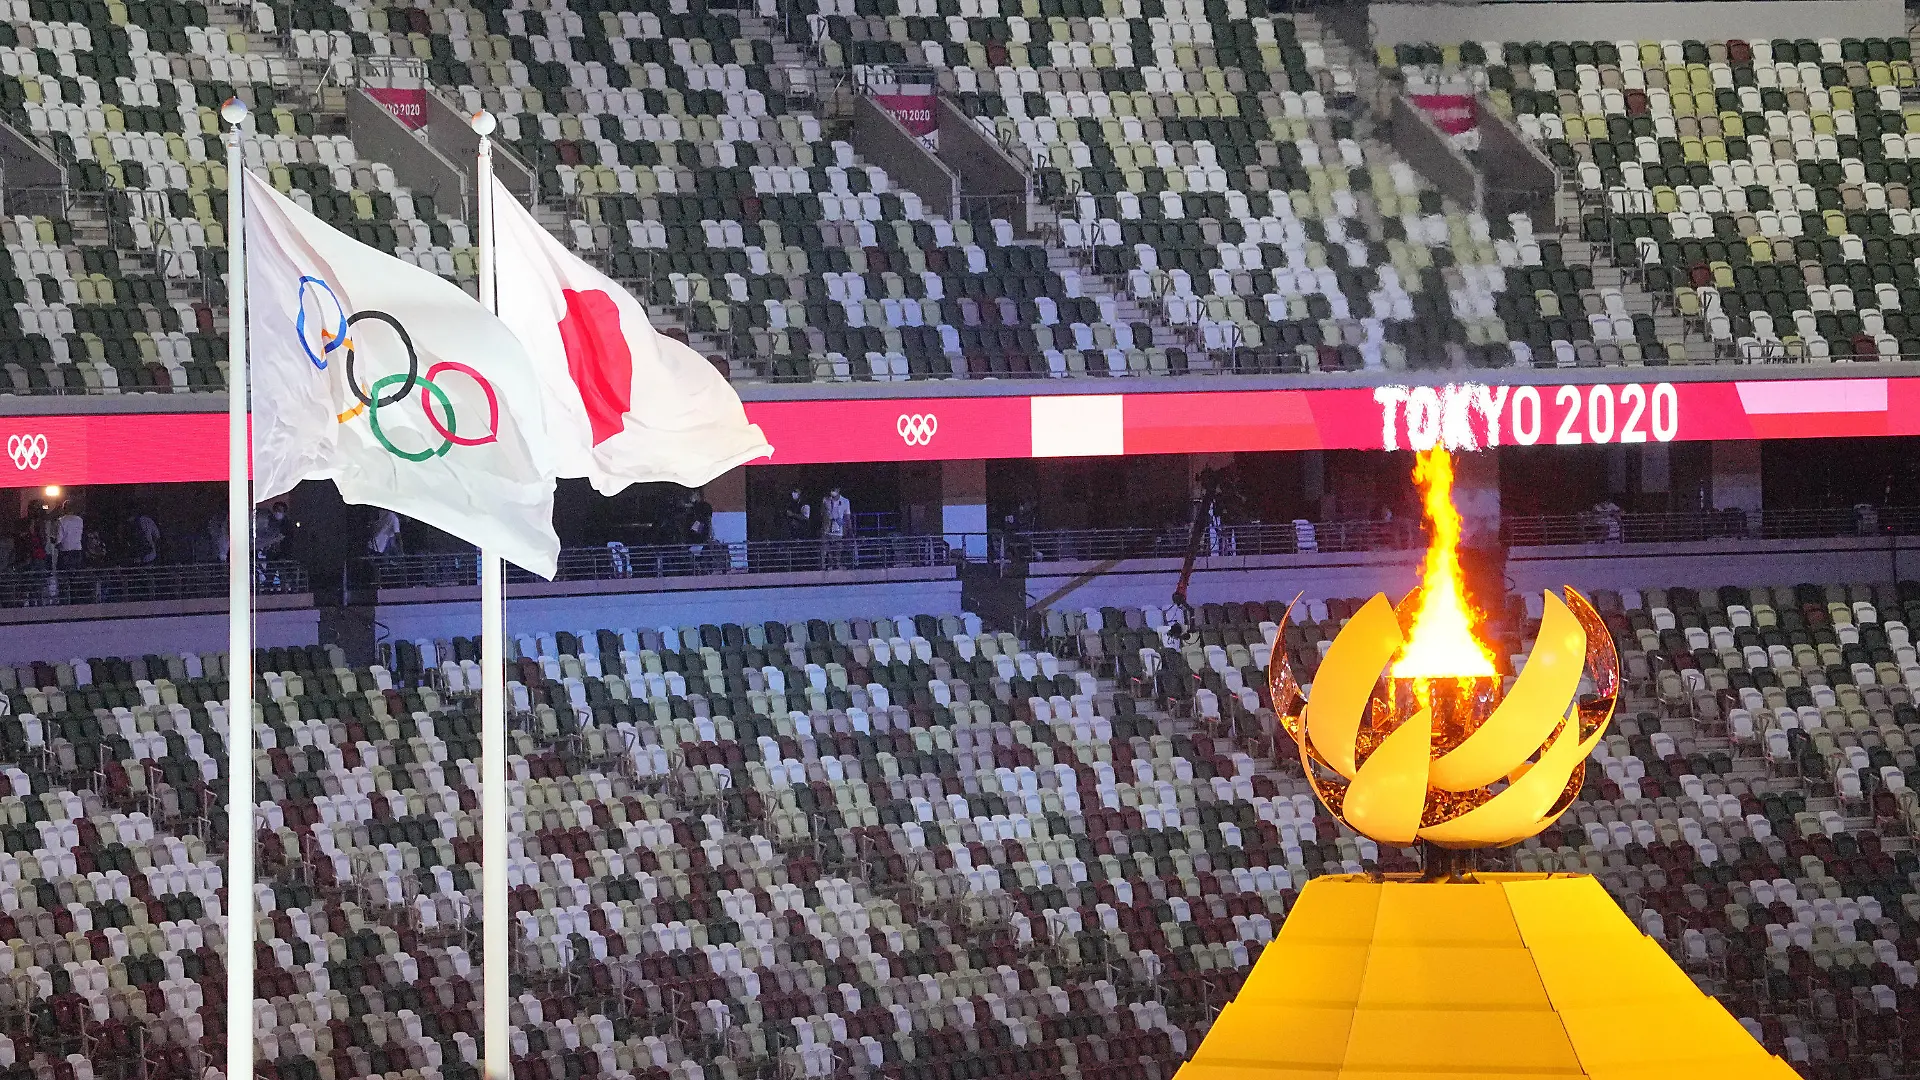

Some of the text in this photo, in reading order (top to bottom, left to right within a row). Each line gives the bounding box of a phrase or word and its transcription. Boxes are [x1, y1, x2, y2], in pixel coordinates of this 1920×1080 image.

[400, 104, 420, 116] 2020
[909, 109, 930, 121] 2020
[1373, 382, 1679, 451] TOKYO 2020
